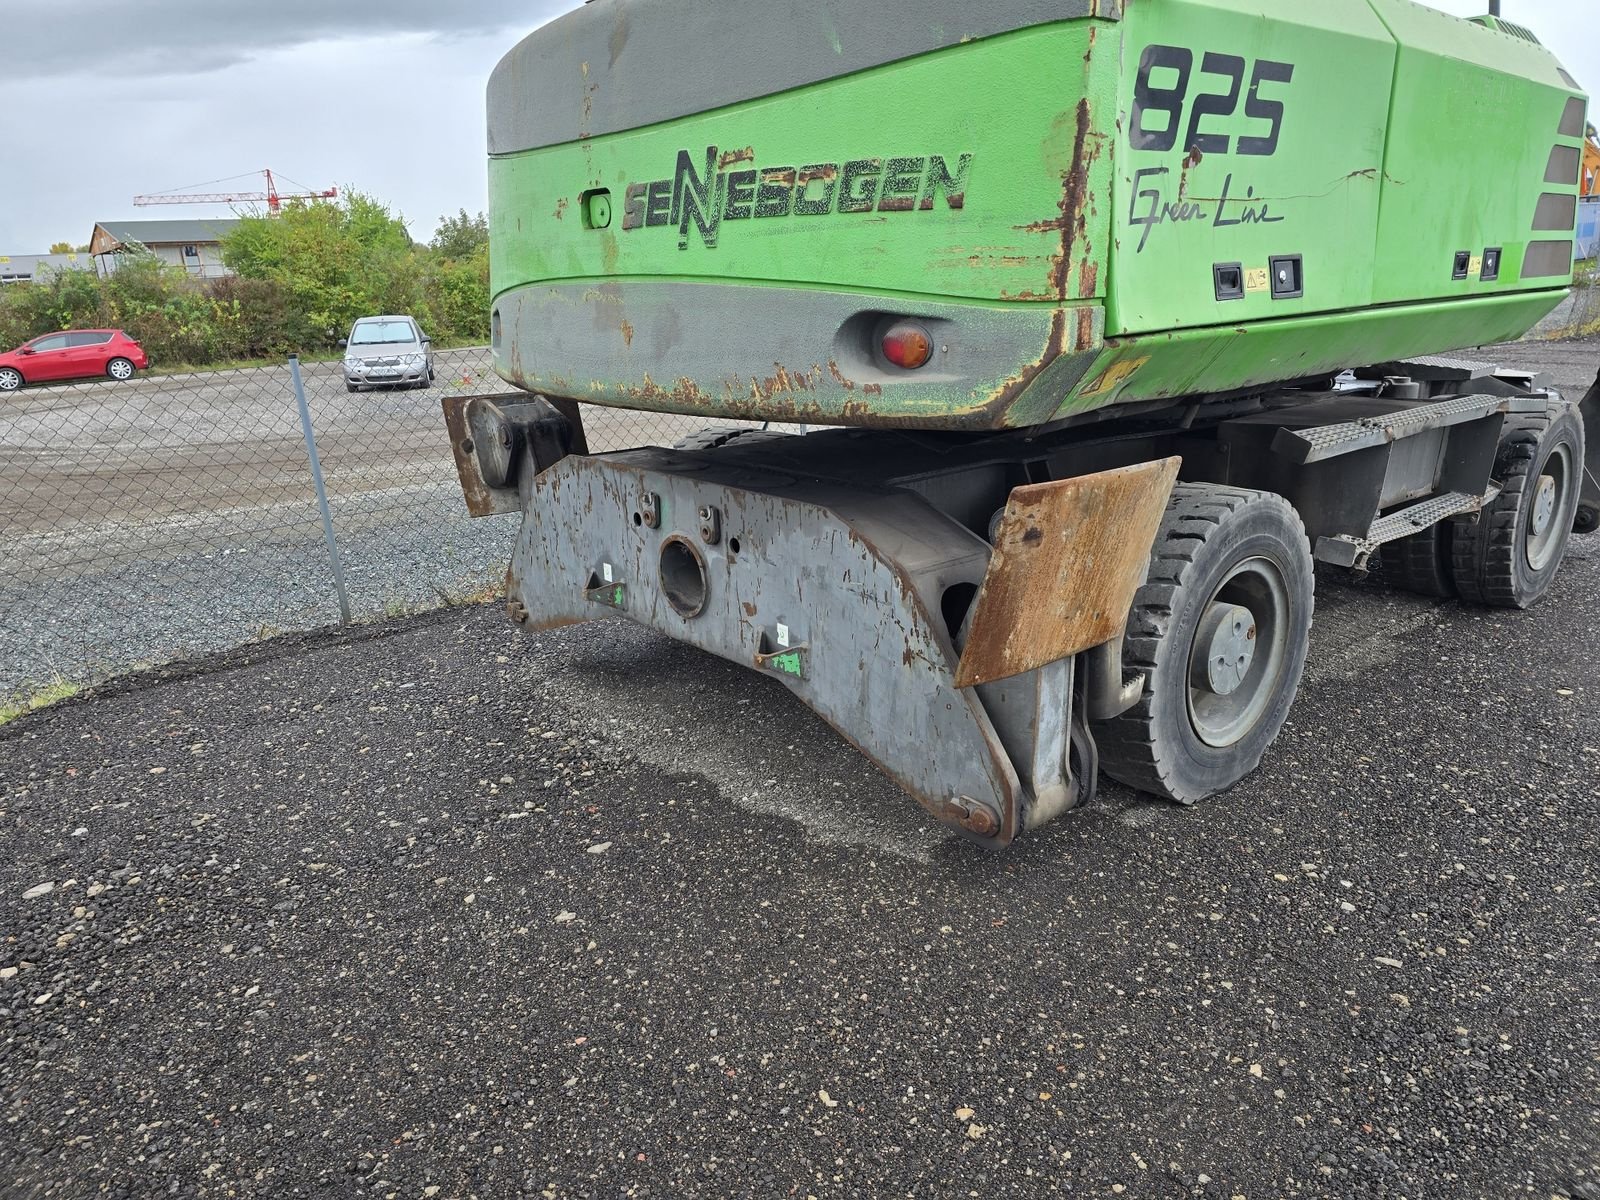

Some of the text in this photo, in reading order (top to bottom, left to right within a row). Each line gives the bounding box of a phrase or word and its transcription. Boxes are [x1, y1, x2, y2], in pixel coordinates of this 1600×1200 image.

[1129, 44, 1295, 156] 825
[622, 145, 973, 250] SENNEBOGEN
[1128, 167, 1284, 253] Green Line
